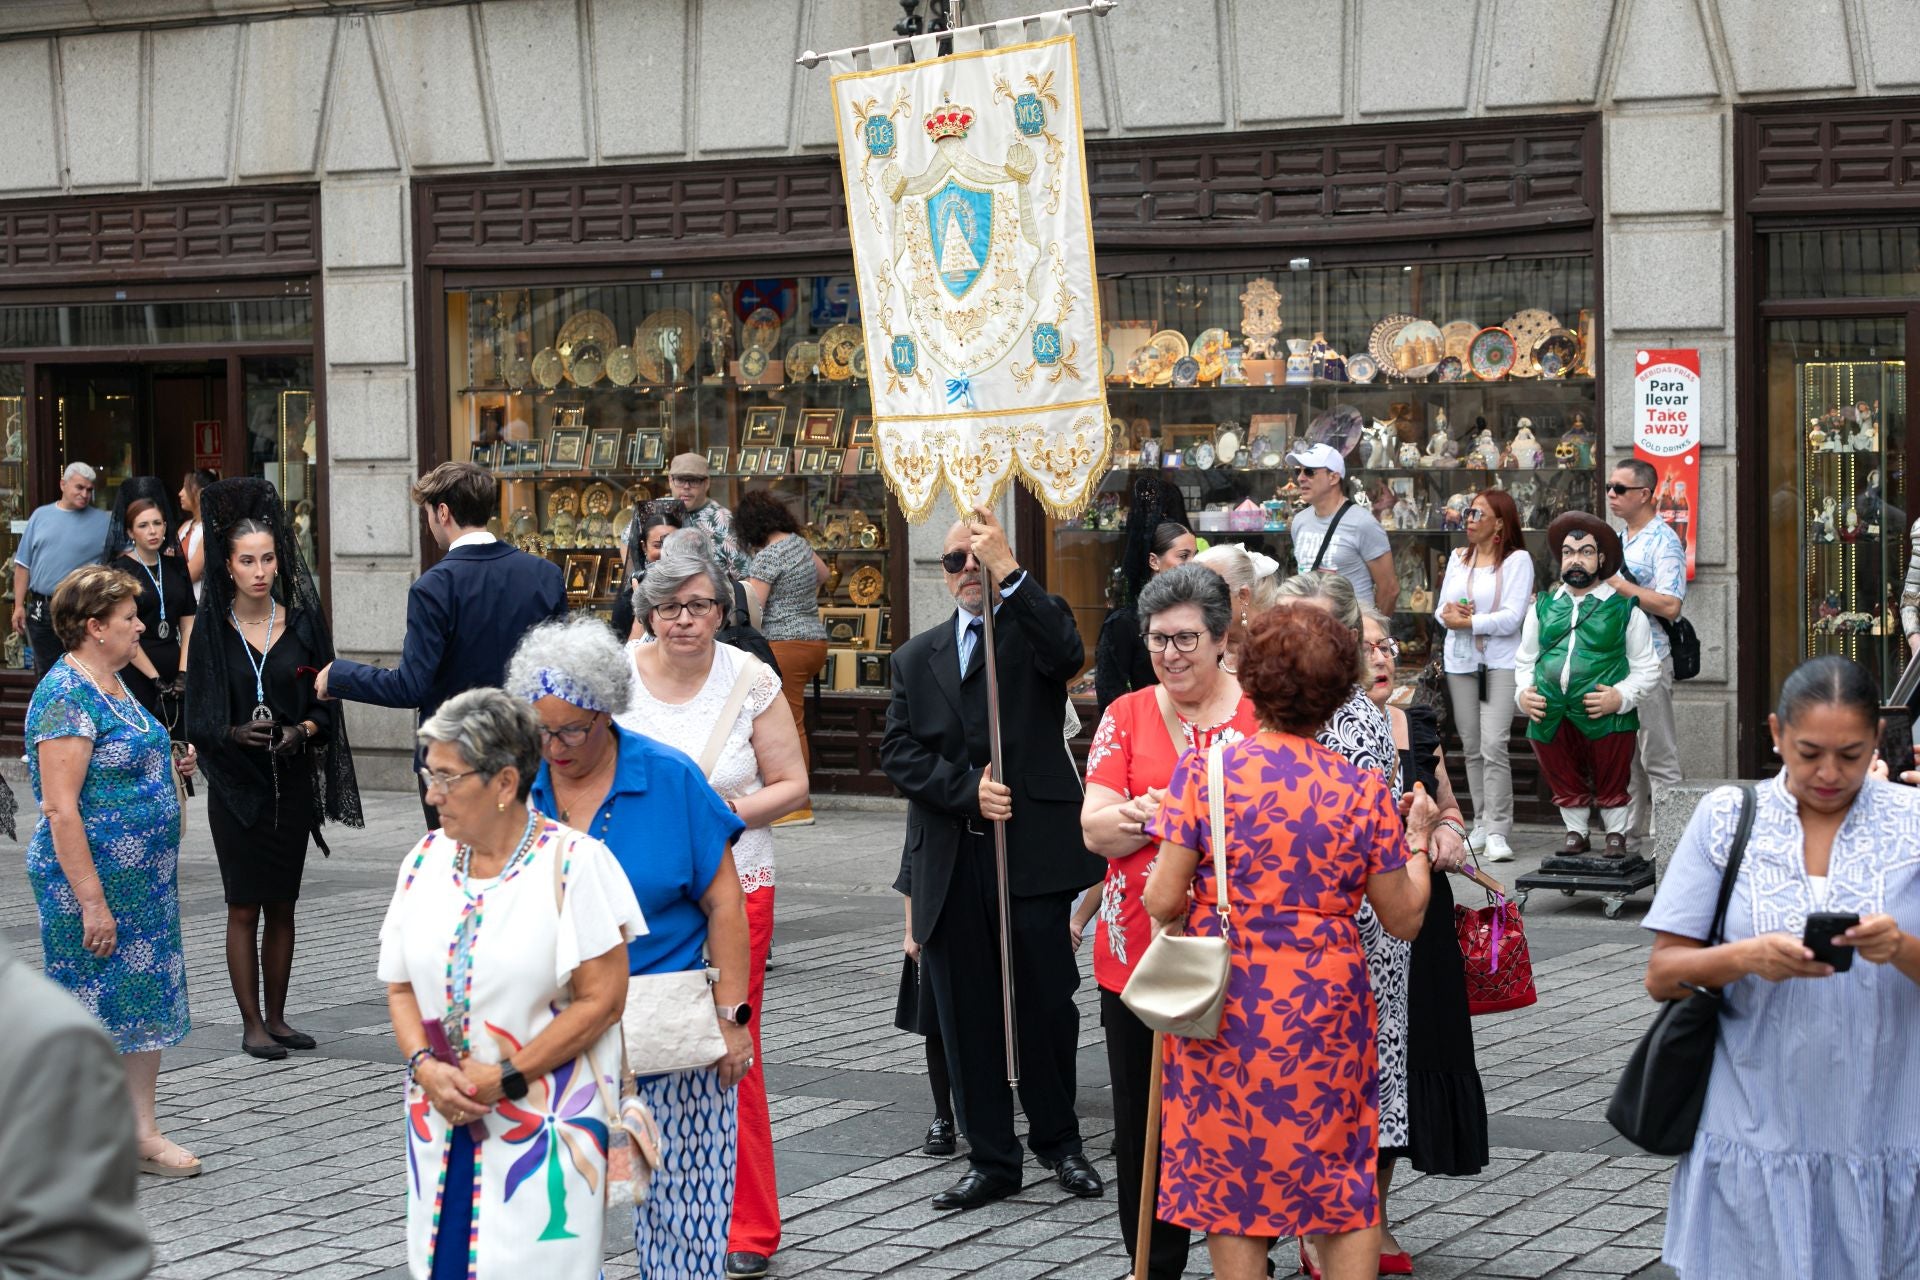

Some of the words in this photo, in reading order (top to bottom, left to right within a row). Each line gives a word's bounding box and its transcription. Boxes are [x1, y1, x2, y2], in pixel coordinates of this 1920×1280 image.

[1037, 334, 1055, 353] OS
[896, 346, 911, 365] DI
[1639, 366, 1672, 382] BEBIDAS
[1650, 380, 1684, 392] Para
[1645, 393, 1689, 405] llevar
[1646, 408, 1687, 421] Take
[1644, 424, 1689, 437] away
[1641, 438, 1661, 452] COLD
[1662, 439, 1691, 453] DRINKS
